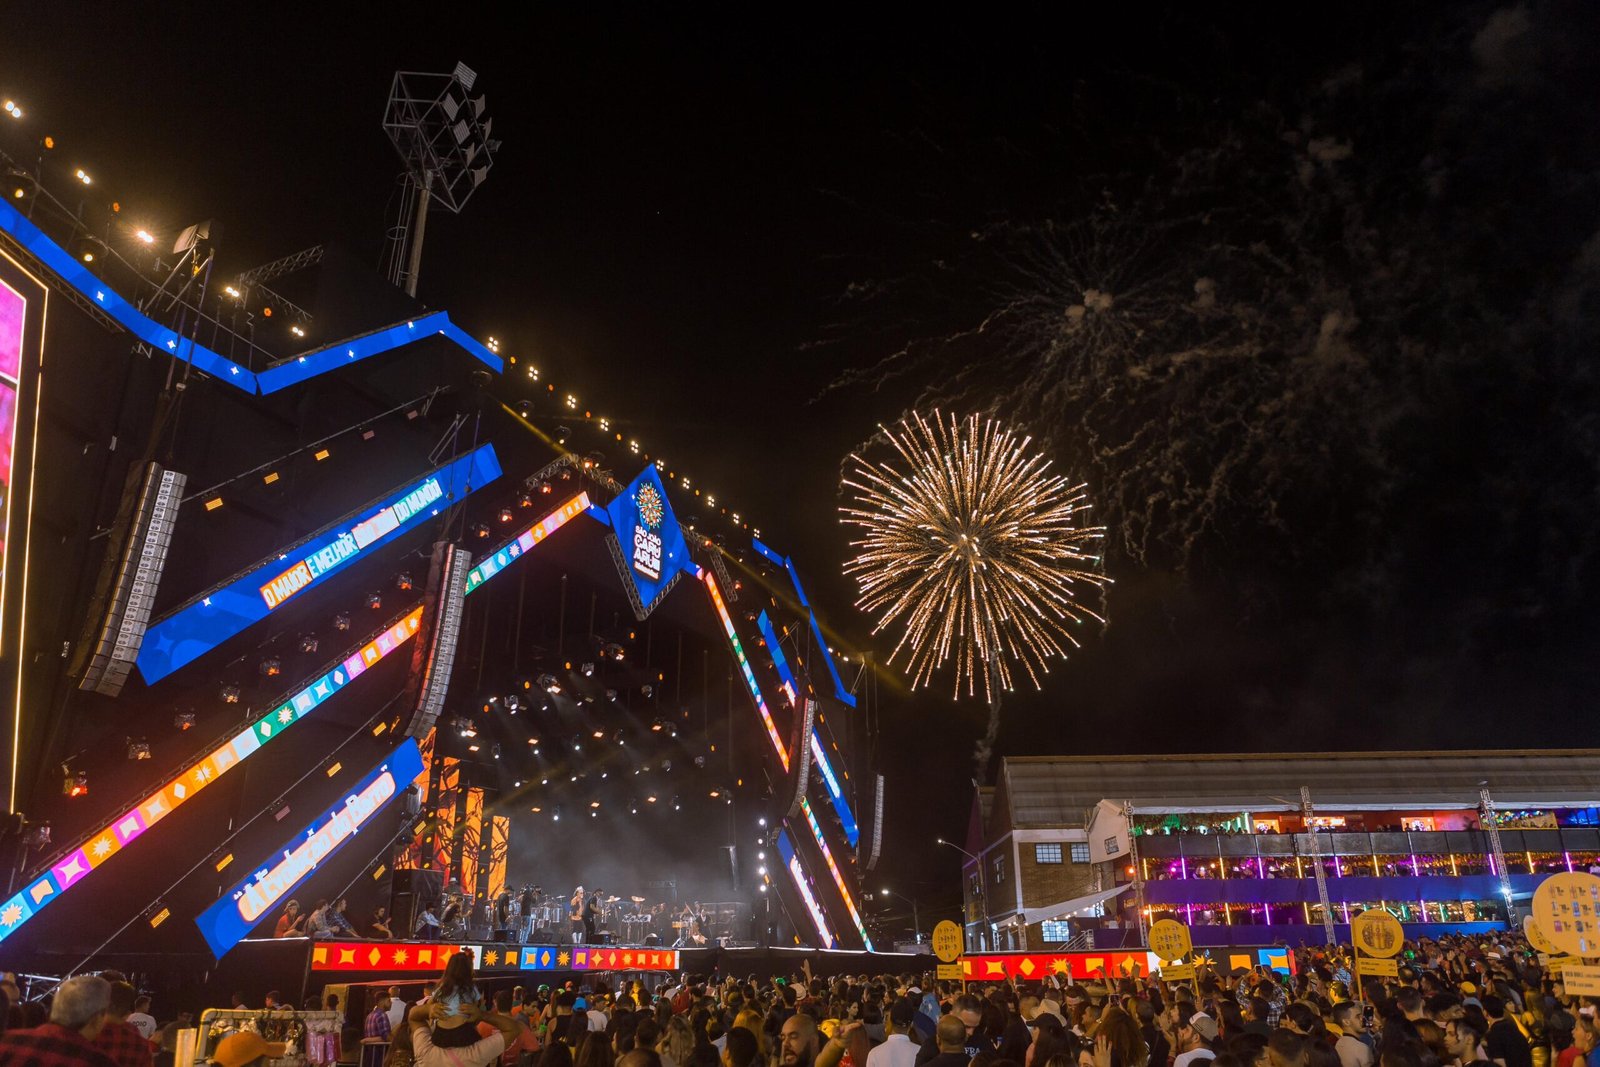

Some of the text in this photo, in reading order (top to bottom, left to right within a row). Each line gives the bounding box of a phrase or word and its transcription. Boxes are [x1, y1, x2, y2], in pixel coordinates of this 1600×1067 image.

[262, 588, 277, 607] O
[271, 565, 313, 602] MAIOR
[304, 558, 319, 581] E
[312, 533, 358, 573] MELHOR
[392, 502, 411, 523] DO
